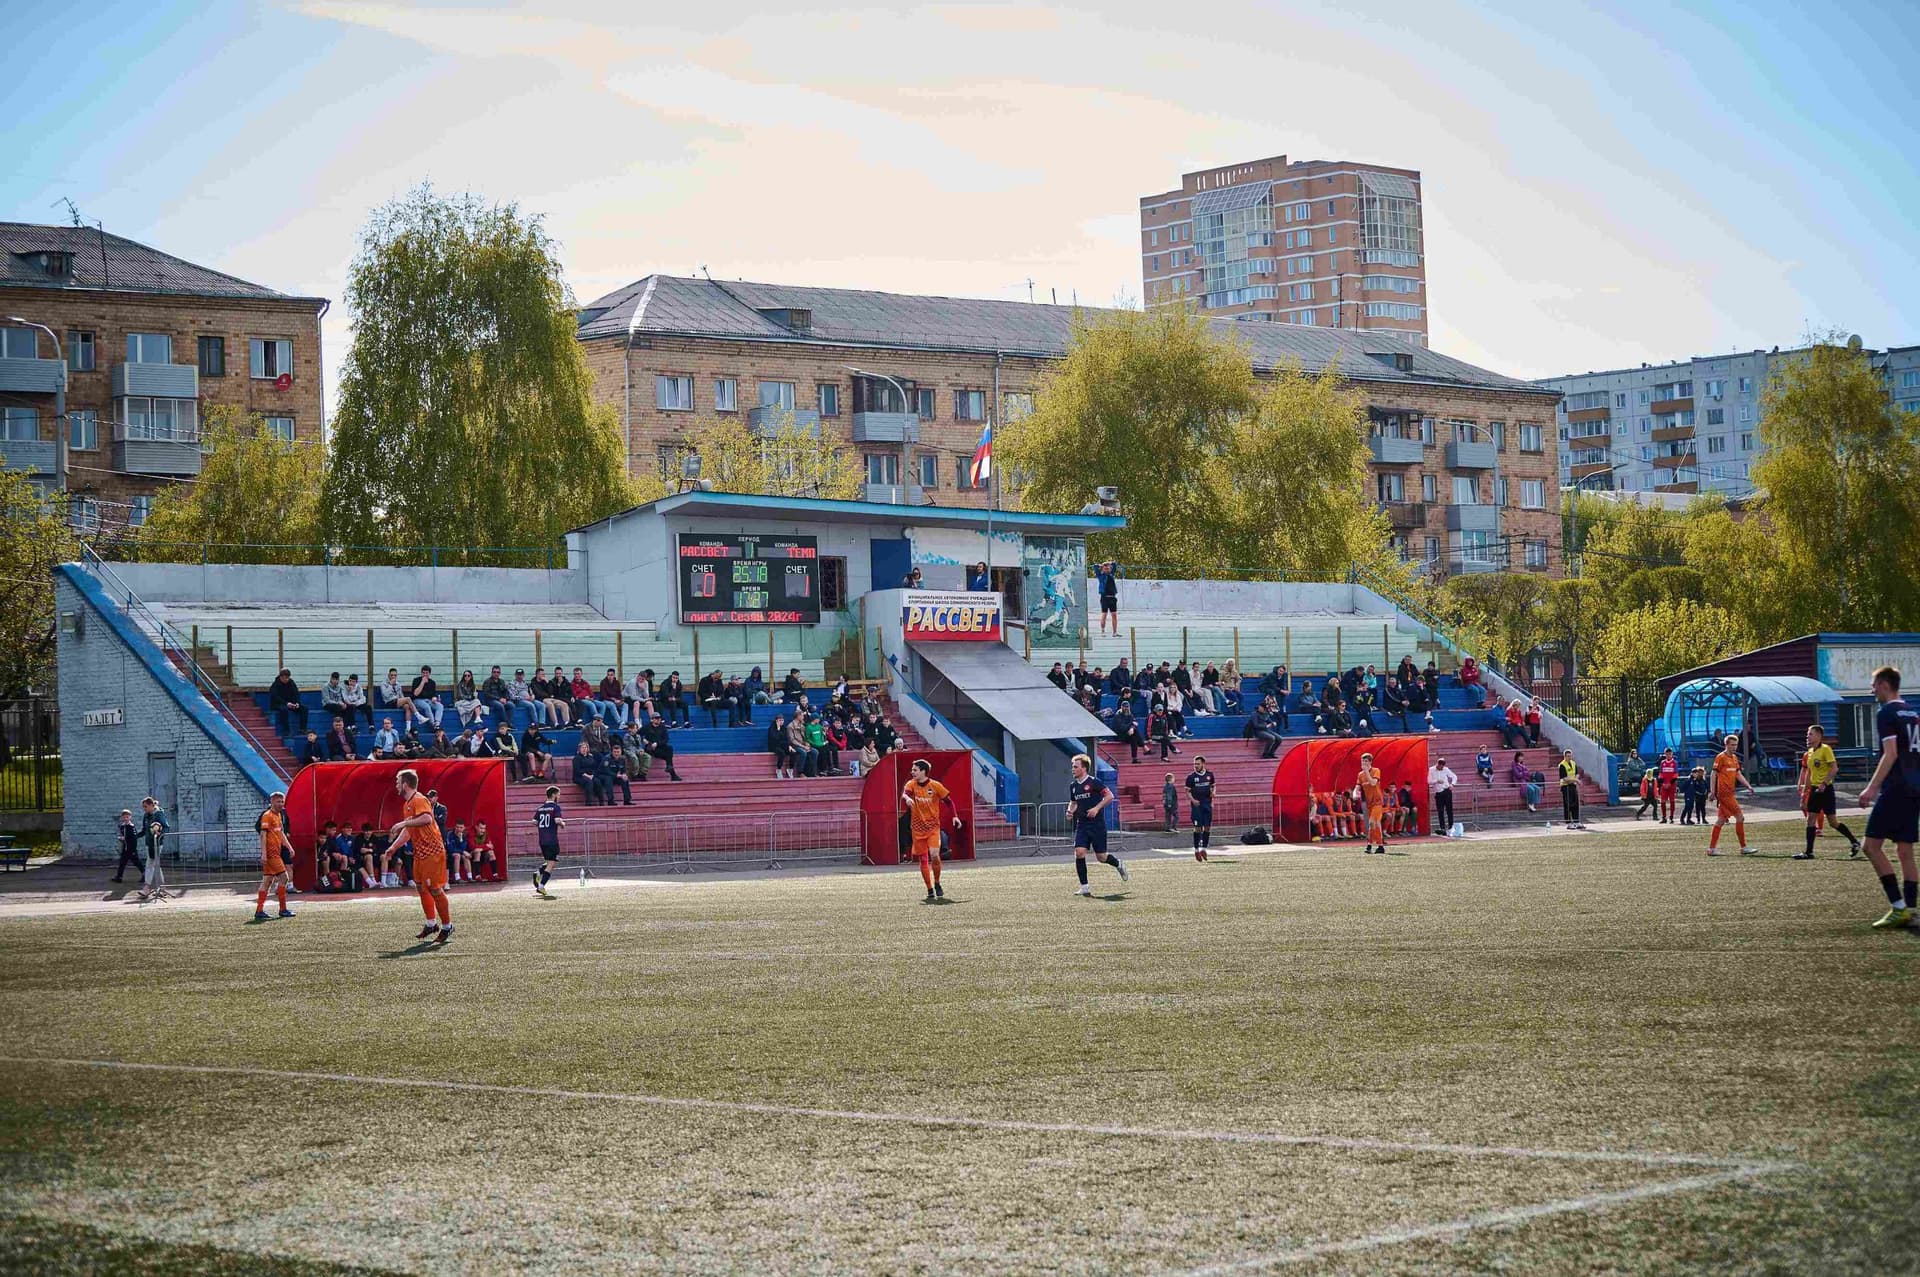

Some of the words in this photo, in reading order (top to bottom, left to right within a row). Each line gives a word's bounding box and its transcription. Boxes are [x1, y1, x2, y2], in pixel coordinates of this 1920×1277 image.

[680, 546, 729, 557] РАССВЕТ
[786, 547, 816, 558] ТЕМП
[691, 564, 714, 573] СЧЕТ
[732, 565, 768, 583] 25:18
[785, 565, 808, 574] СЧЕТ
[703, 572, 716, 597] 0
[730, 611, 765, 622] Сезон
[907, 607, 997, 632] РАССВЕТ
[84, 712, 116, 724] ТУАЛЕТ
[539, 813, 550, 828] 20
